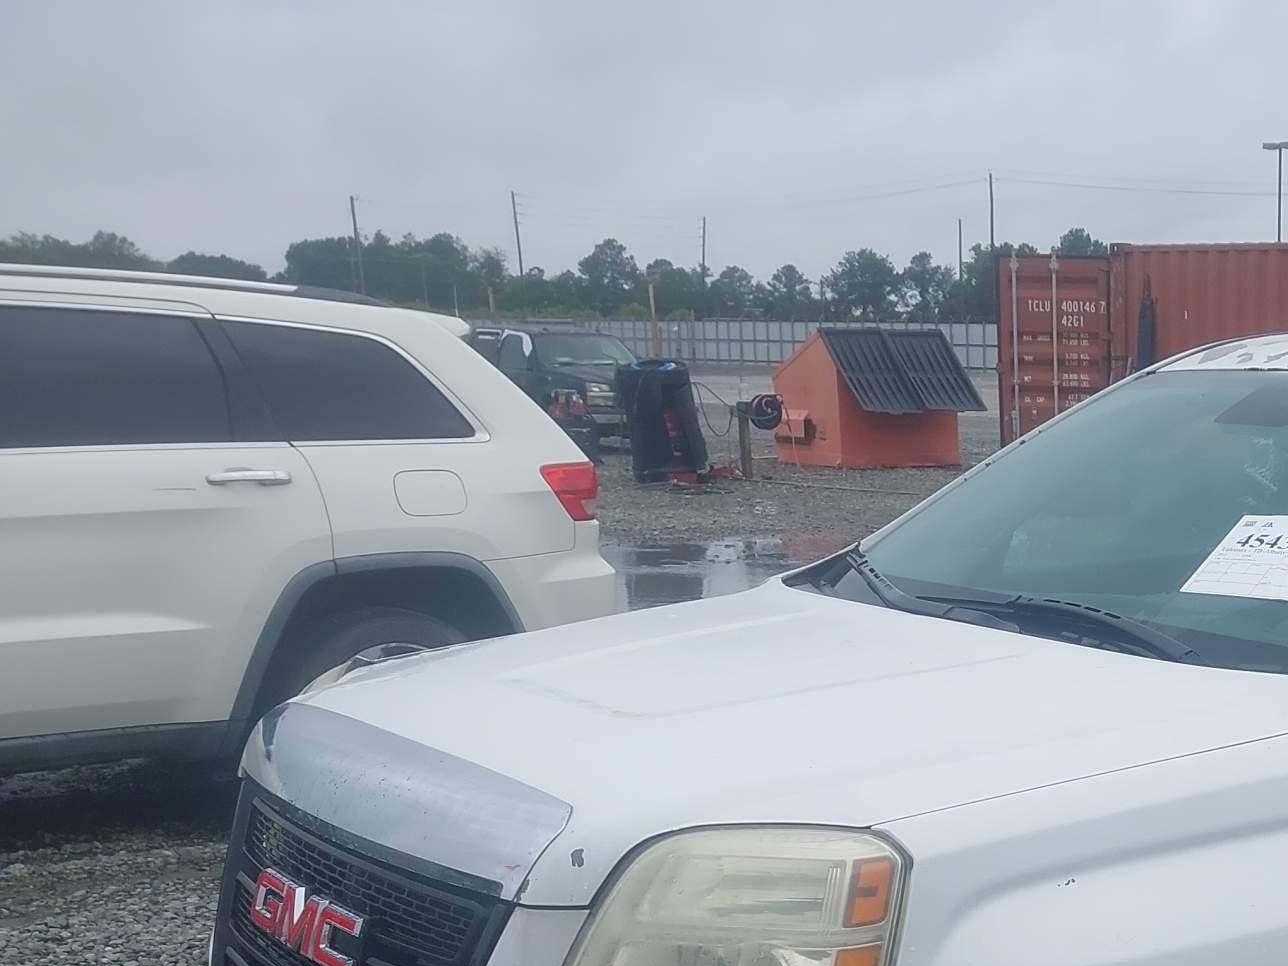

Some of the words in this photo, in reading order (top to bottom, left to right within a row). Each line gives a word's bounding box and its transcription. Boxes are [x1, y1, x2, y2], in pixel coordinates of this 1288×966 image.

[1027, 299, 1051, 312] TCLU
[1061, 300, 1096, 313] 400146
[1099, 301, 1107, 313] 7
[1061, 315, 1084, 328] 42G1
